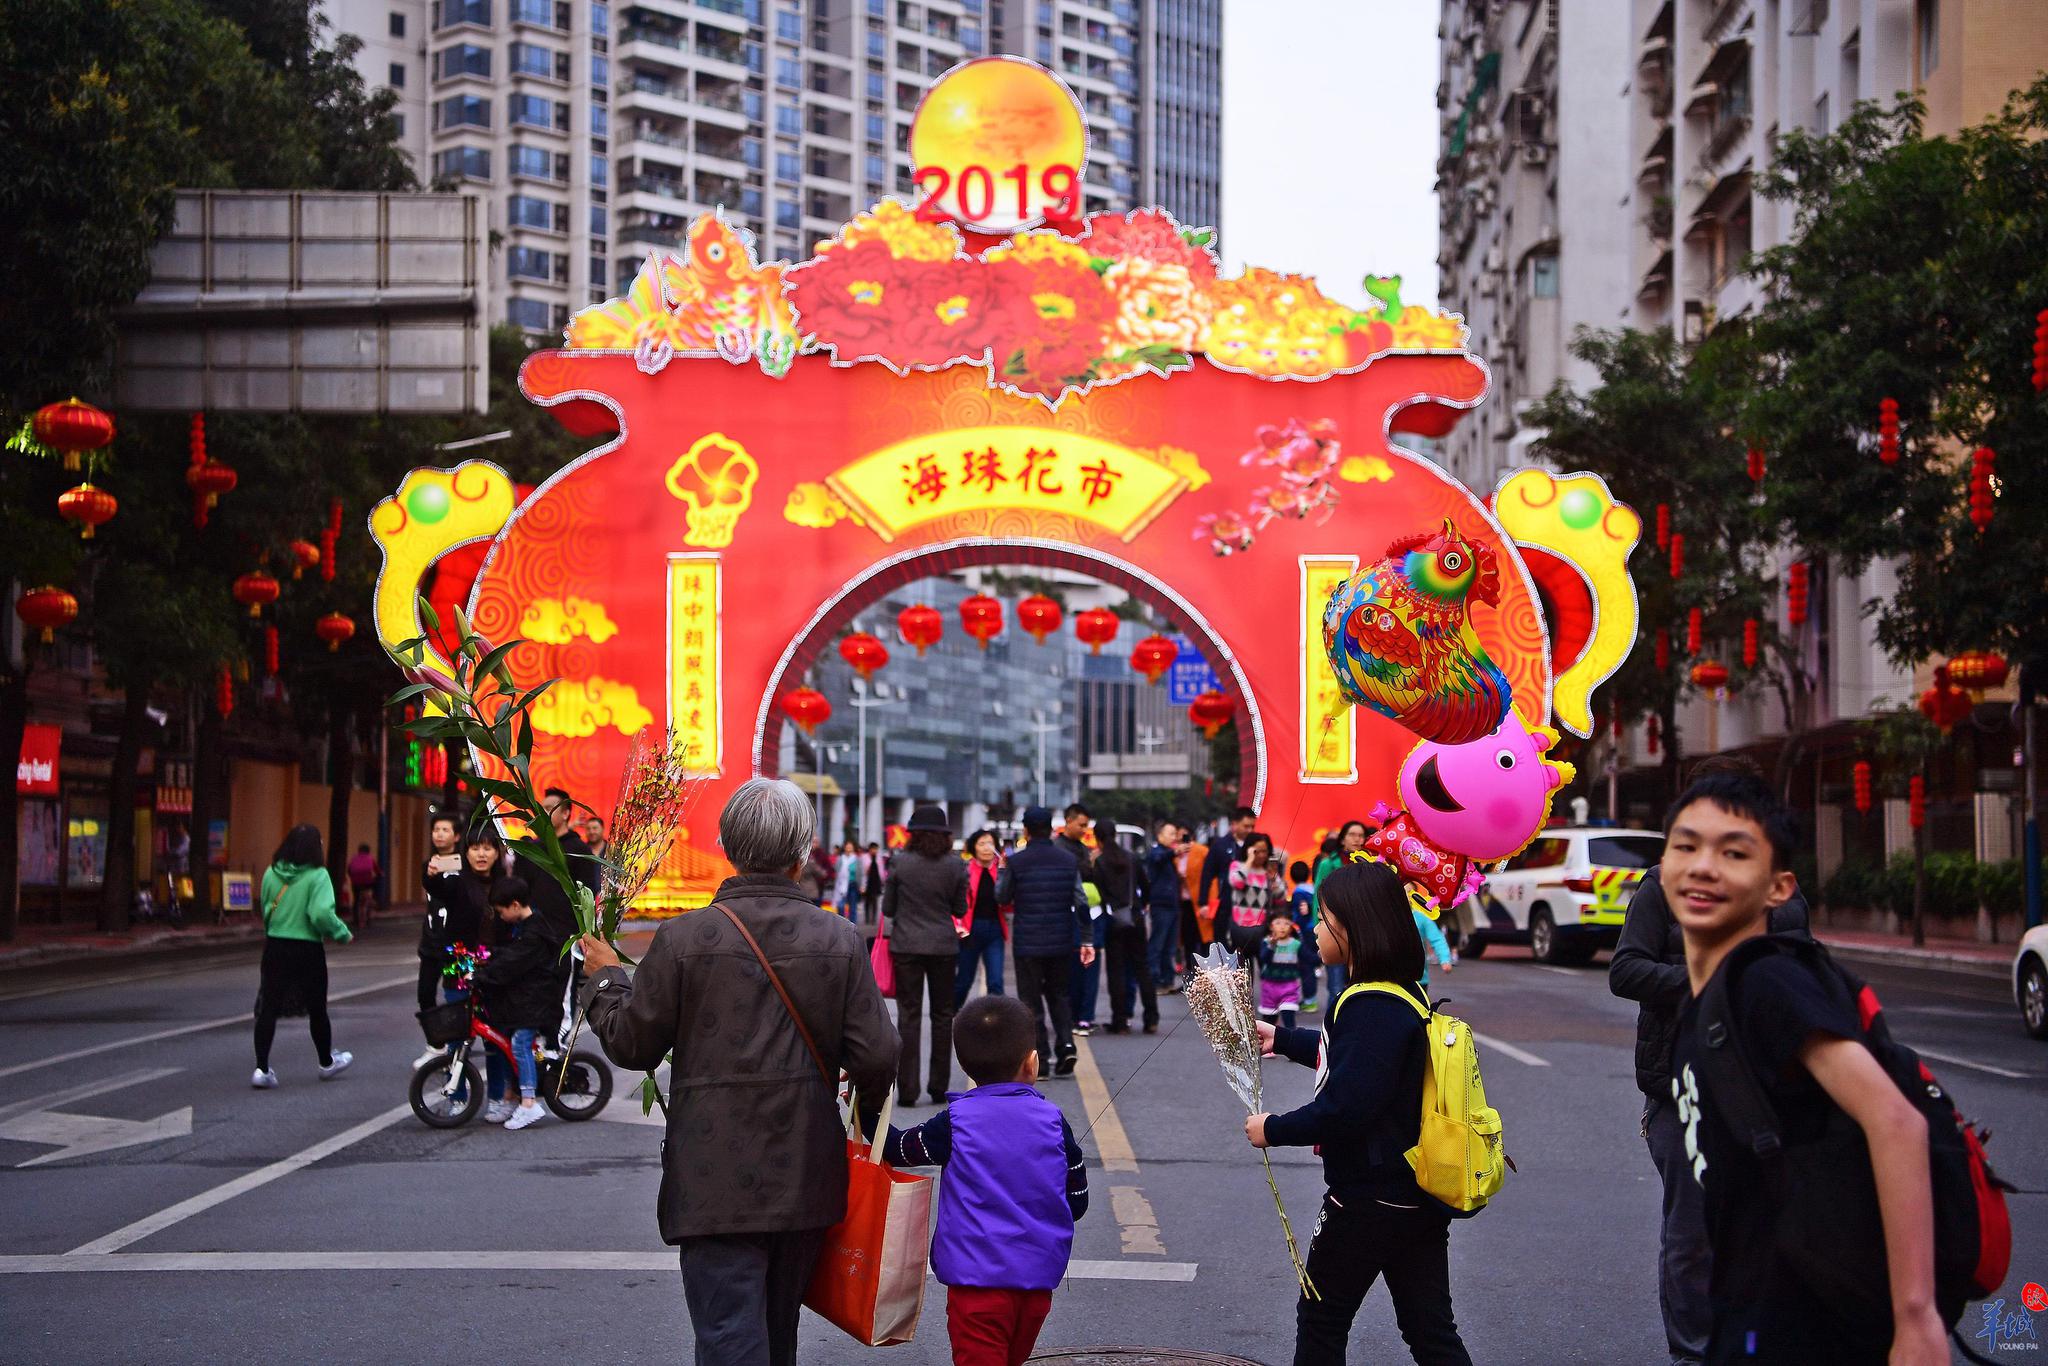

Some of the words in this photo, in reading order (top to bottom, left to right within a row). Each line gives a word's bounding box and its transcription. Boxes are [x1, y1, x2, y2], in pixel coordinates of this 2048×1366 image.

[911, 163, 1081, 223] 2019
[902, 446, 1122, 506] 海珠花市
